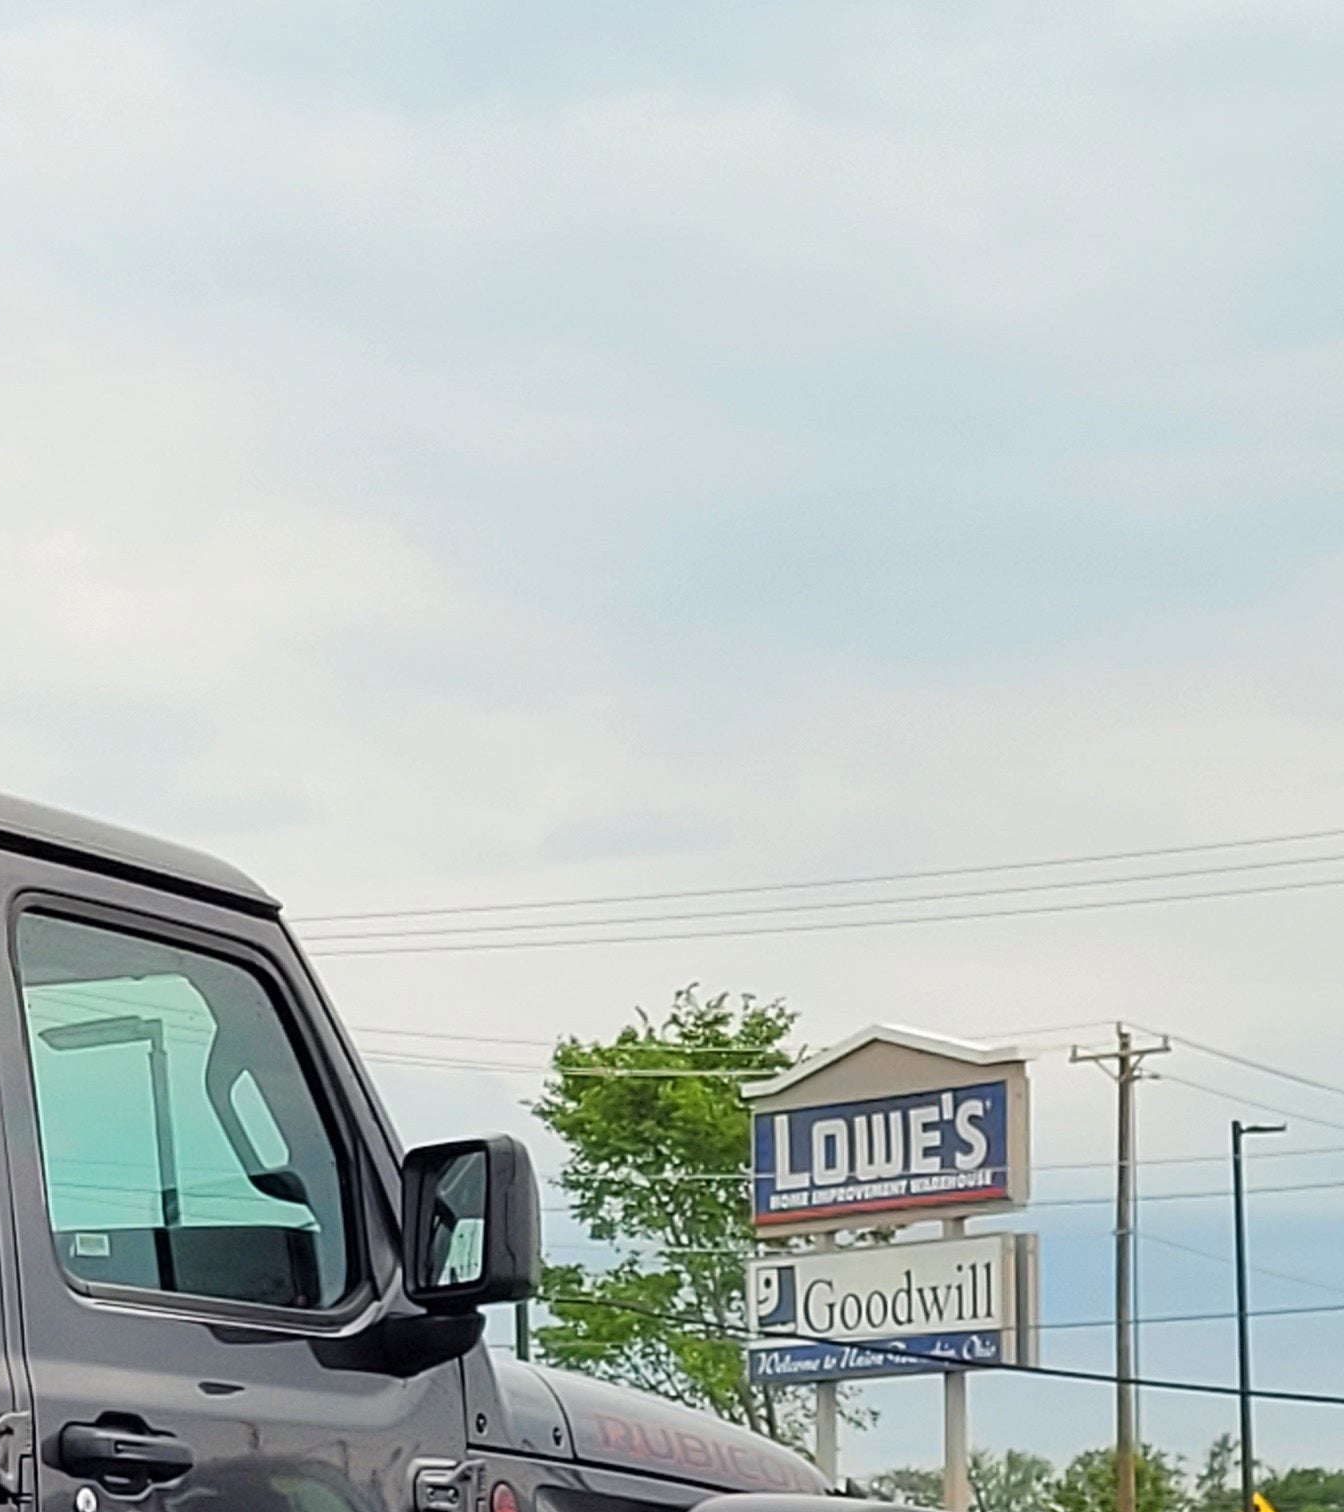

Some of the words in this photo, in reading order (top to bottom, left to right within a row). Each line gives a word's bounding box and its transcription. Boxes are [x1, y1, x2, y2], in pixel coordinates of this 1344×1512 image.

[773, 1092, 988, 1191] LOWE'S
[770, 1191, 809, 1210] HOME
[812, 1180, 908, 1205] IMPROVEMENT
[910, 1168, 993, 1194] WAREHOUSE
[803, 1261, 995, 1334] Goodwill
[758, 1352, 820, 1375] Welcome
[823, 1355, 837, 1370] to
